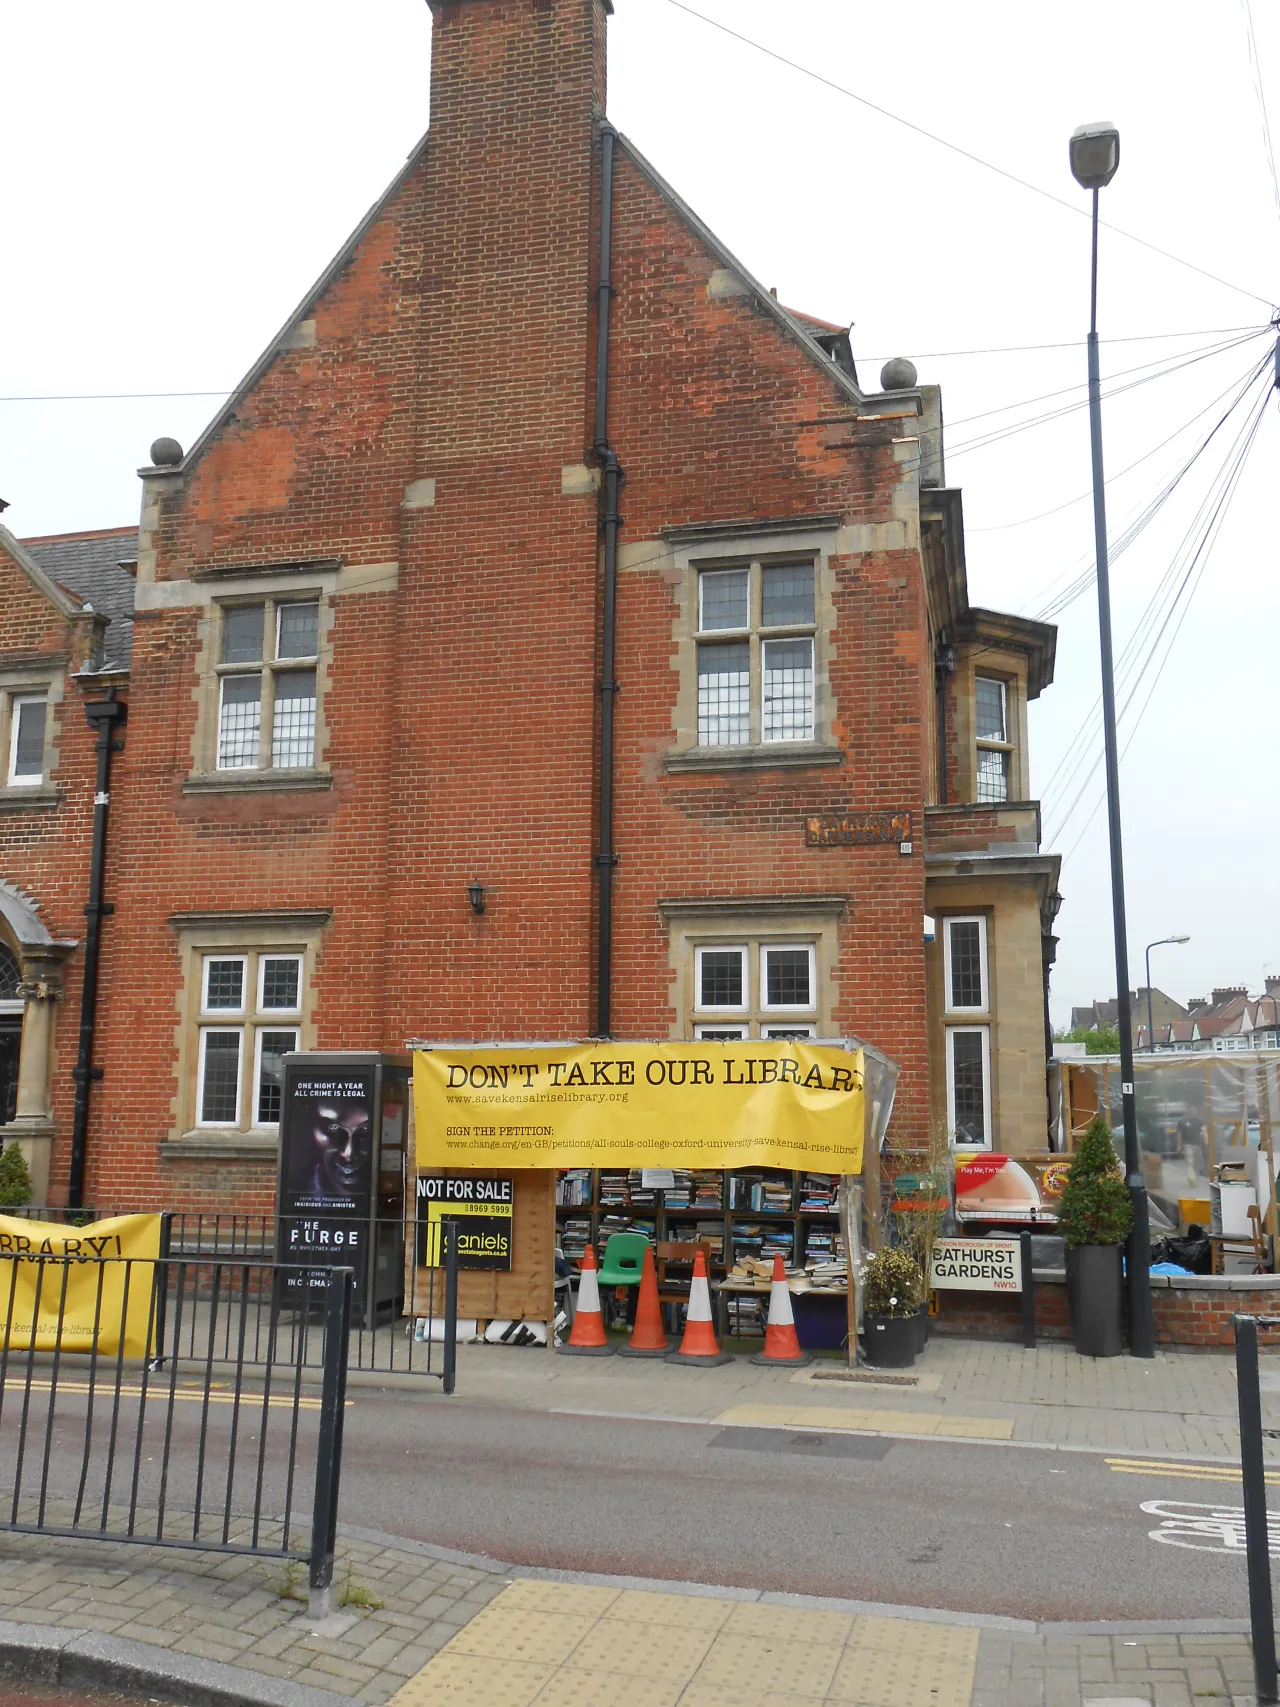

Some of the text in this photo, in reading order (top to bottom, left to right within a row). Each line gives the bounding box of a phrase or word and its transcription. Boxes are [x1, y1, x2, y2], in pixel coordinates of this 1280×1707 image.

[446, 1064, 539, 1088] DON'T
[547, 1061, 635, 1086] TAKE
[645, 1060, 714, 1085] OUR
[446, 1092, 629, 1103] www.savekensalriselibrary.org
[446, 1126, 554, 1136] SIGN THE PETITION:
[417, 1179, 510, 1200] NOT FOR SALE
[469, 1204, 488, 1213] 8969
[491, 1205, 510, 1213] 5999
[932, 1248, 1015, 1263] BATHURST
[935, 1264, 1014, 1279] GARDENS
